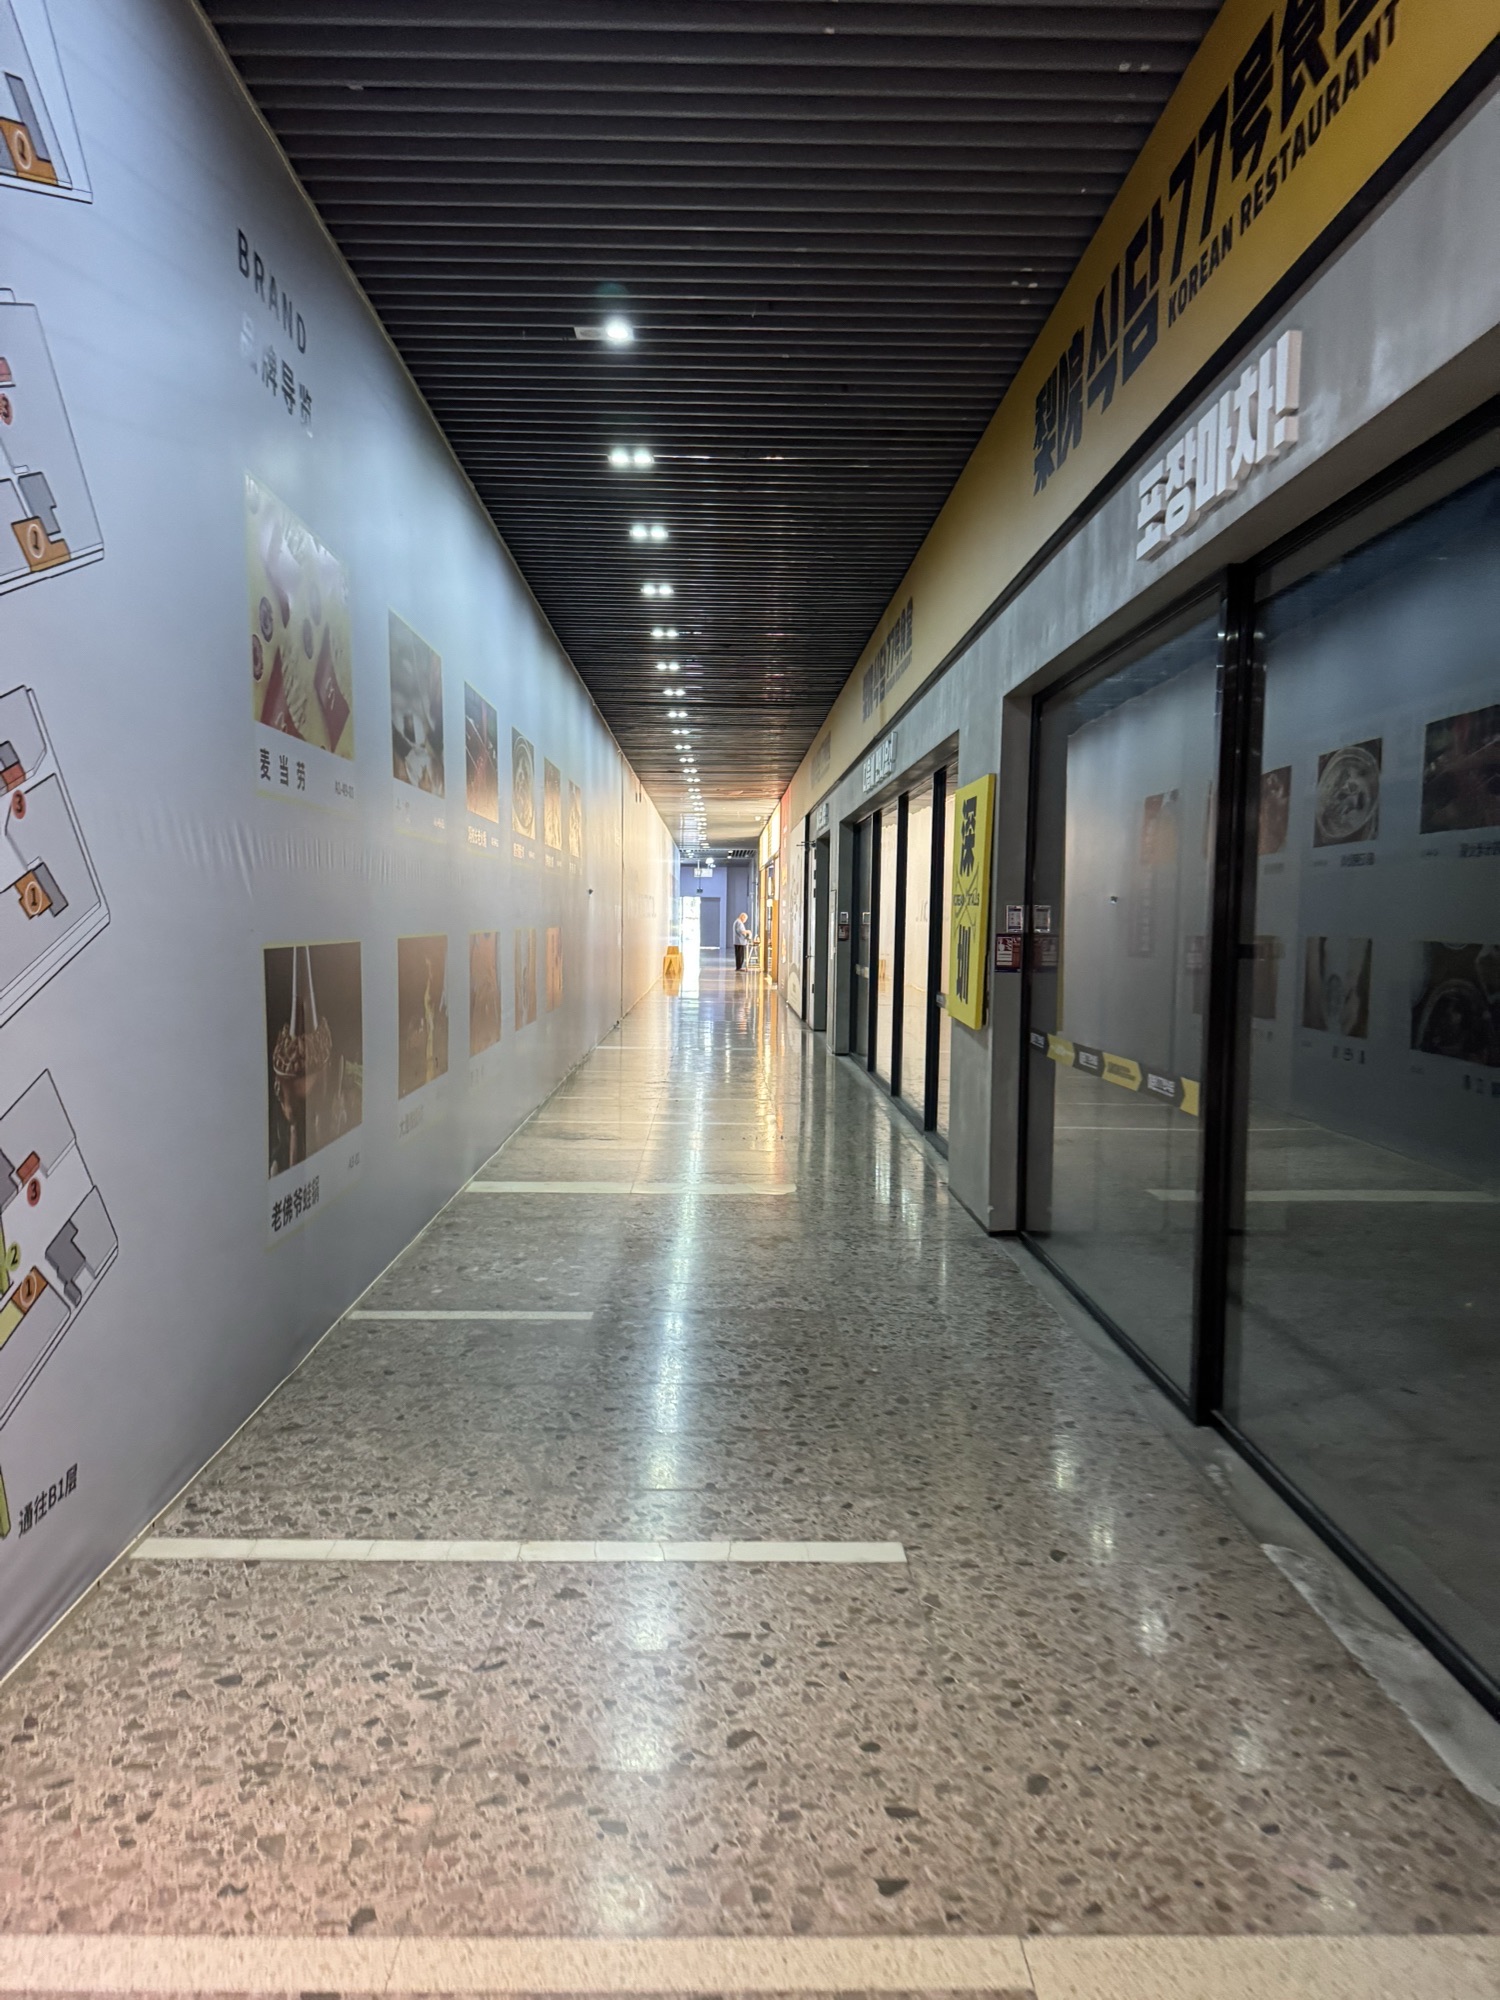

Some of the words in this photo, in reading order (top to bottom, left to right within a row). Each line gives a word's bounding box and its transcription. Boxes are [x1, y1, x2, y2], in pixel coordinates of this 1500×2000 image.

[1168, 213, 1234, 328] KOREAN
[1239, 0, 1397, 236] RESTAURANT
[237, 226, 307, 355] BRAND
[1136, 330, 1302, 560] 포장마차!
[259, 747, 306, 792] 麦当劳
[18, 1462, 78, 1539] 通往B1层
